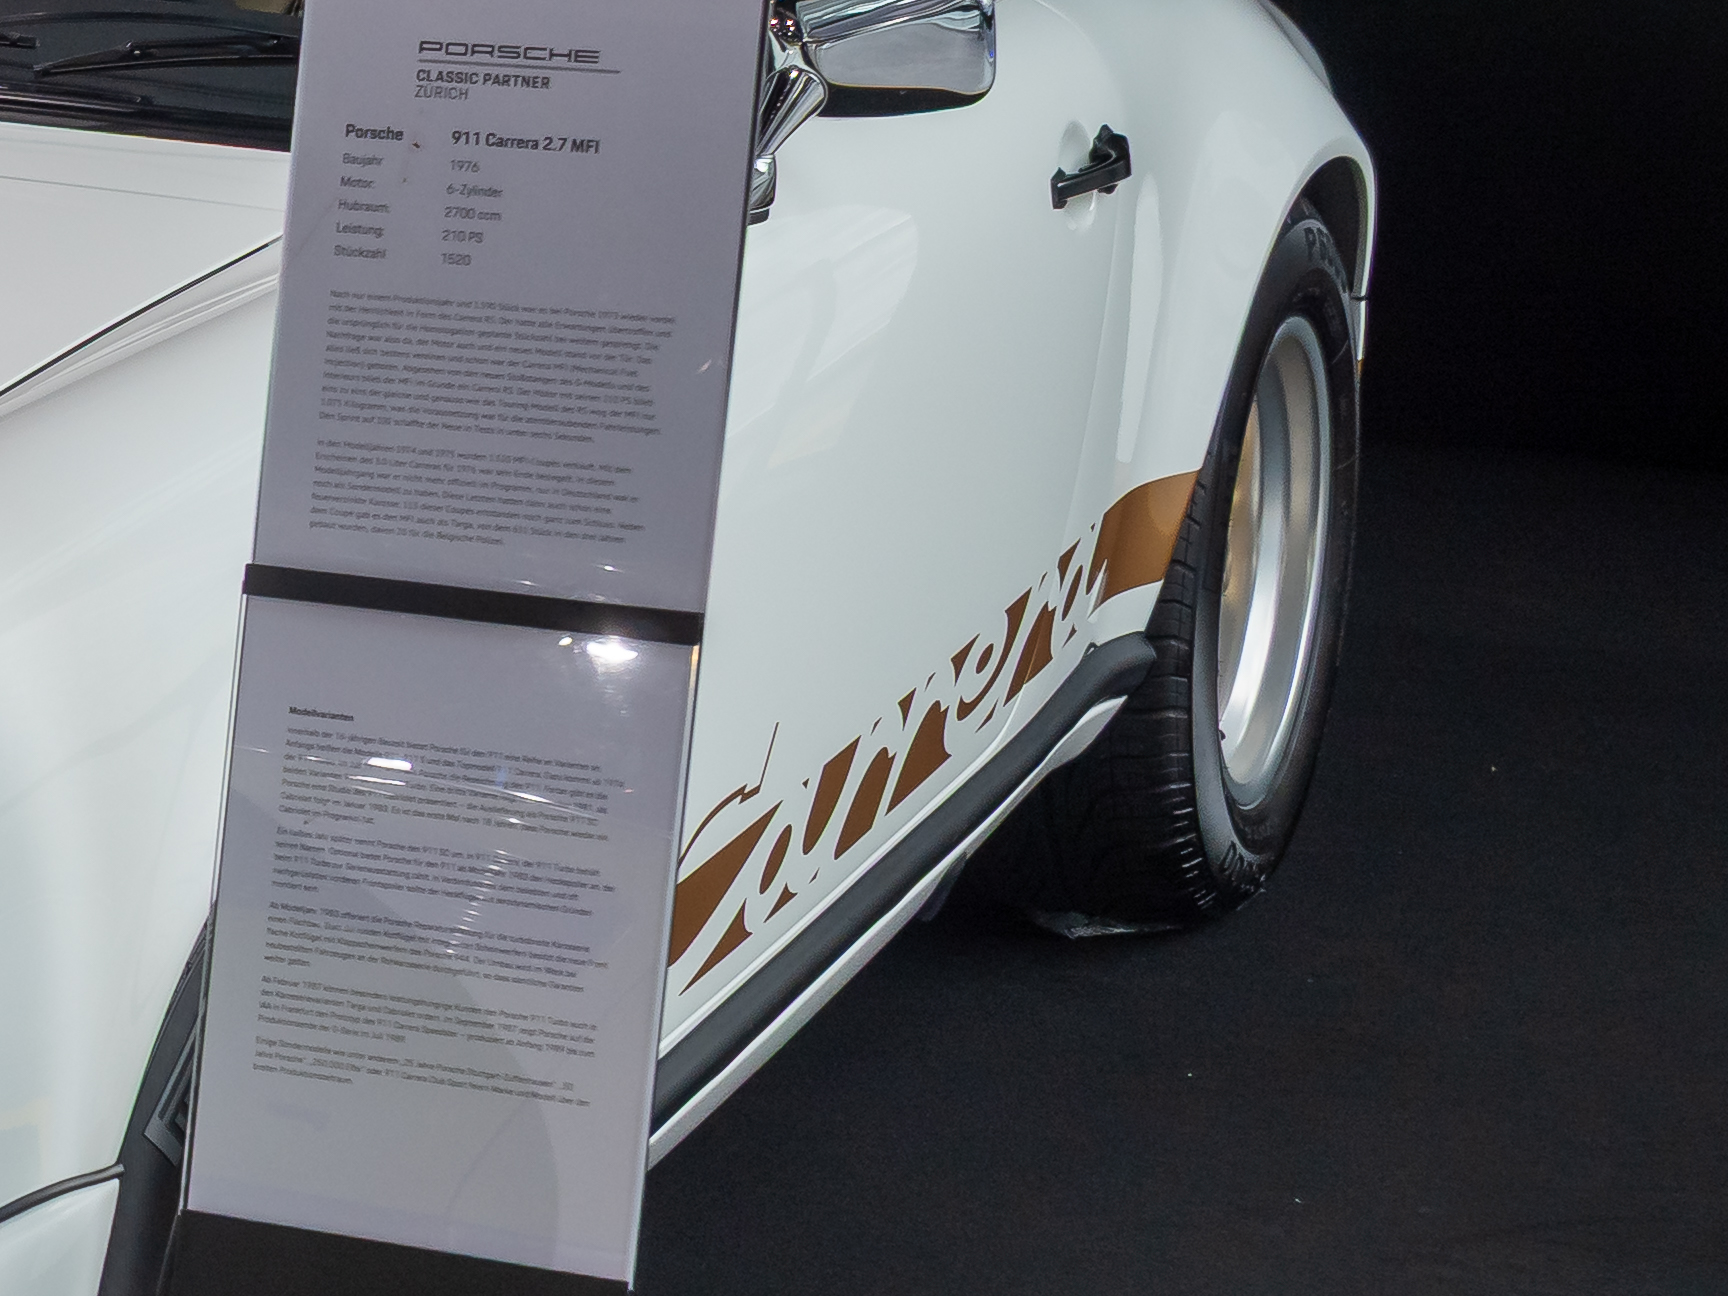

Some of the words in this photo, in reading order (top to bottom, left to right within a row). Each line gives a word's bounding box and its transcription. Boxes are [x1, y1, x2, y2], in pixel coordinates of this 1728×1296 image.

[418, 39, 601, 64] PORSCHE
[416, 68, 479, 85] CLASSIC
[482, 72, 551, 89] PARTNER
[414, 84, 469, 101] ZÜRICH
[345, 123, 404, 141] Porsche
[451, 130, 481, 146] 911
[485, 132, 539, 150] Carrera
[542, 136, 567, 152] 2.7
[570, 138, 601, 155] MFI
[450, 159, 481, 173] 1976
[446, 183, 504, 199] 6-Zylinder
[444, 205, 476, 220] 2700
[441, 229, 466, 243] 210
[467, 231, 484, 244] PS
[441, 252, 472, 266] 1520
